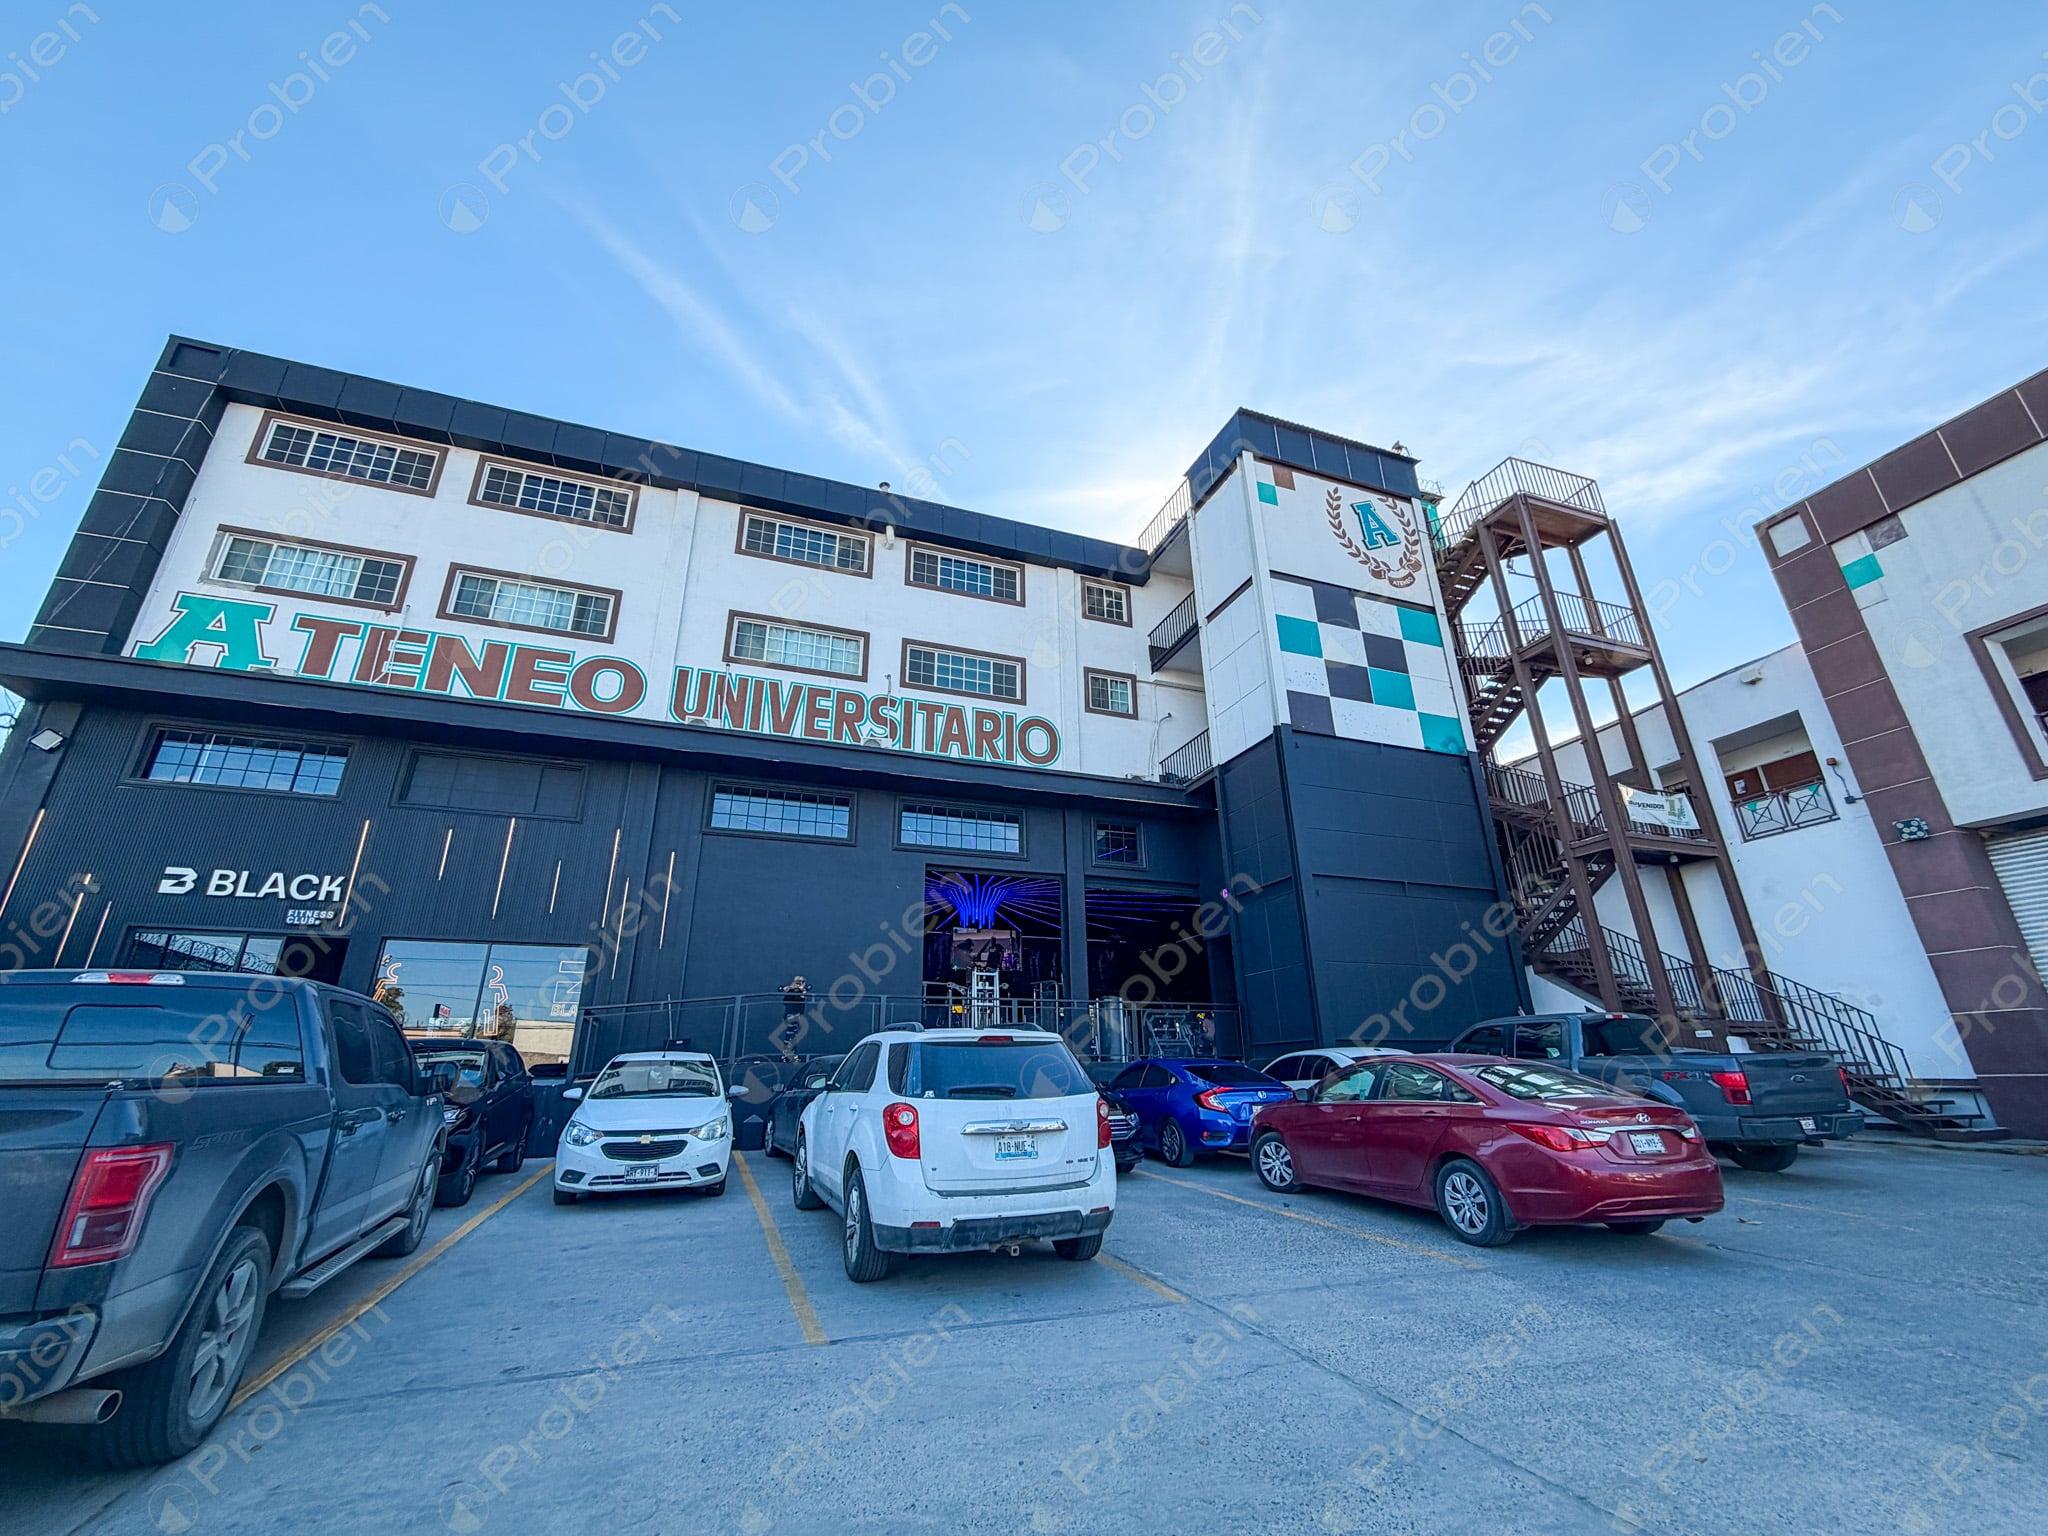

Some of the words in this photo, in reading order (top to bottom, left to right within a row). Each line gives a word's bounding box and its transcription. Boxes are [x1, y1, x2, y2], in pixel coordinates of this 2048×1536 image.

[1350, 500, 1401, 550] A
[669, 665, 1062, 767] UNIVERSITARIO
[1627, 800, 1665, 810] VENIDOS
[205, 869, 346, 902] BLACK
[287, 909, 335, 919] FITNESS
[549, 1002, 579, 1016] BLA
